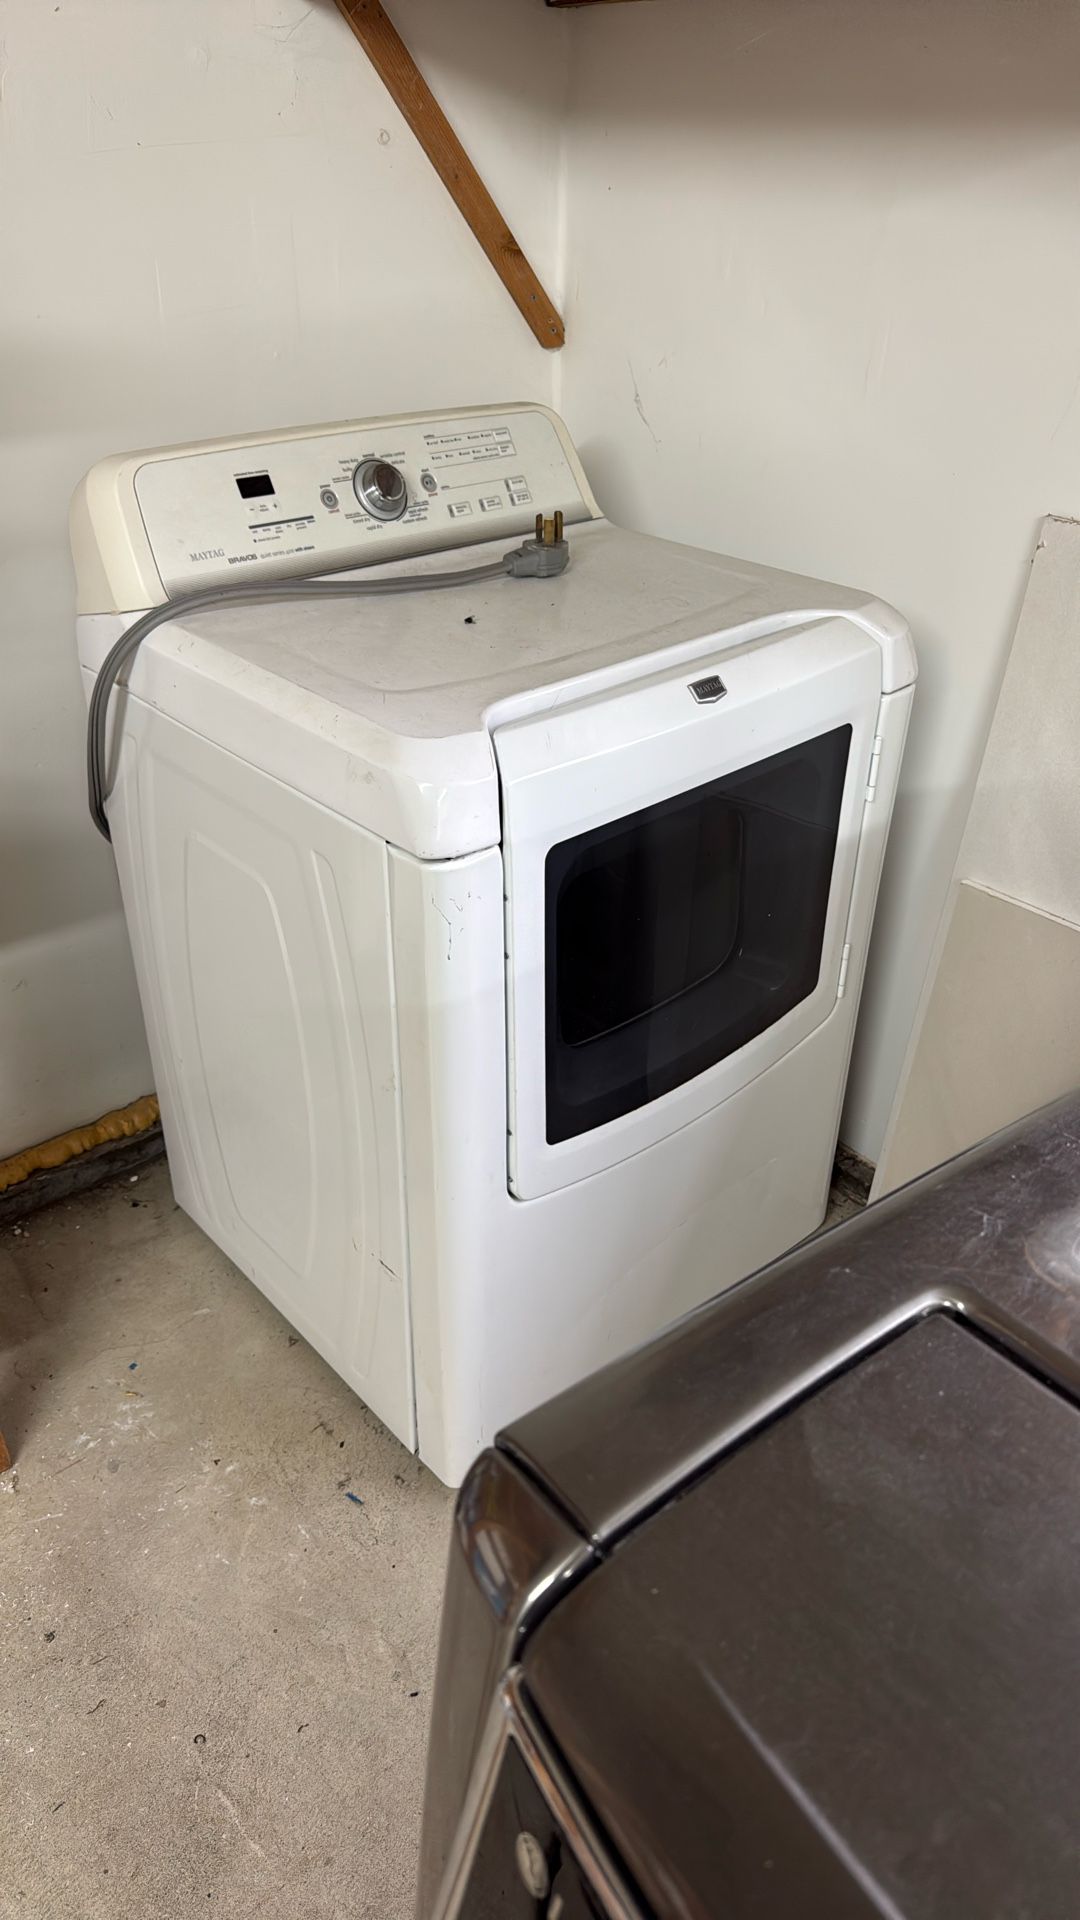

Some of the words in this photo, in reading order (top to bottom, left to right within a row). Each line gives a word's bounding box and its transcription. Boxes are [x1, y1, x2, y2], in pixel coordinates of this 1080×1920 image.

[189, 548, 225, 562] MAYTAG
[227, 553, 258, 564] BRAVOS
[695, 680, 722, 695] MAYTAG
